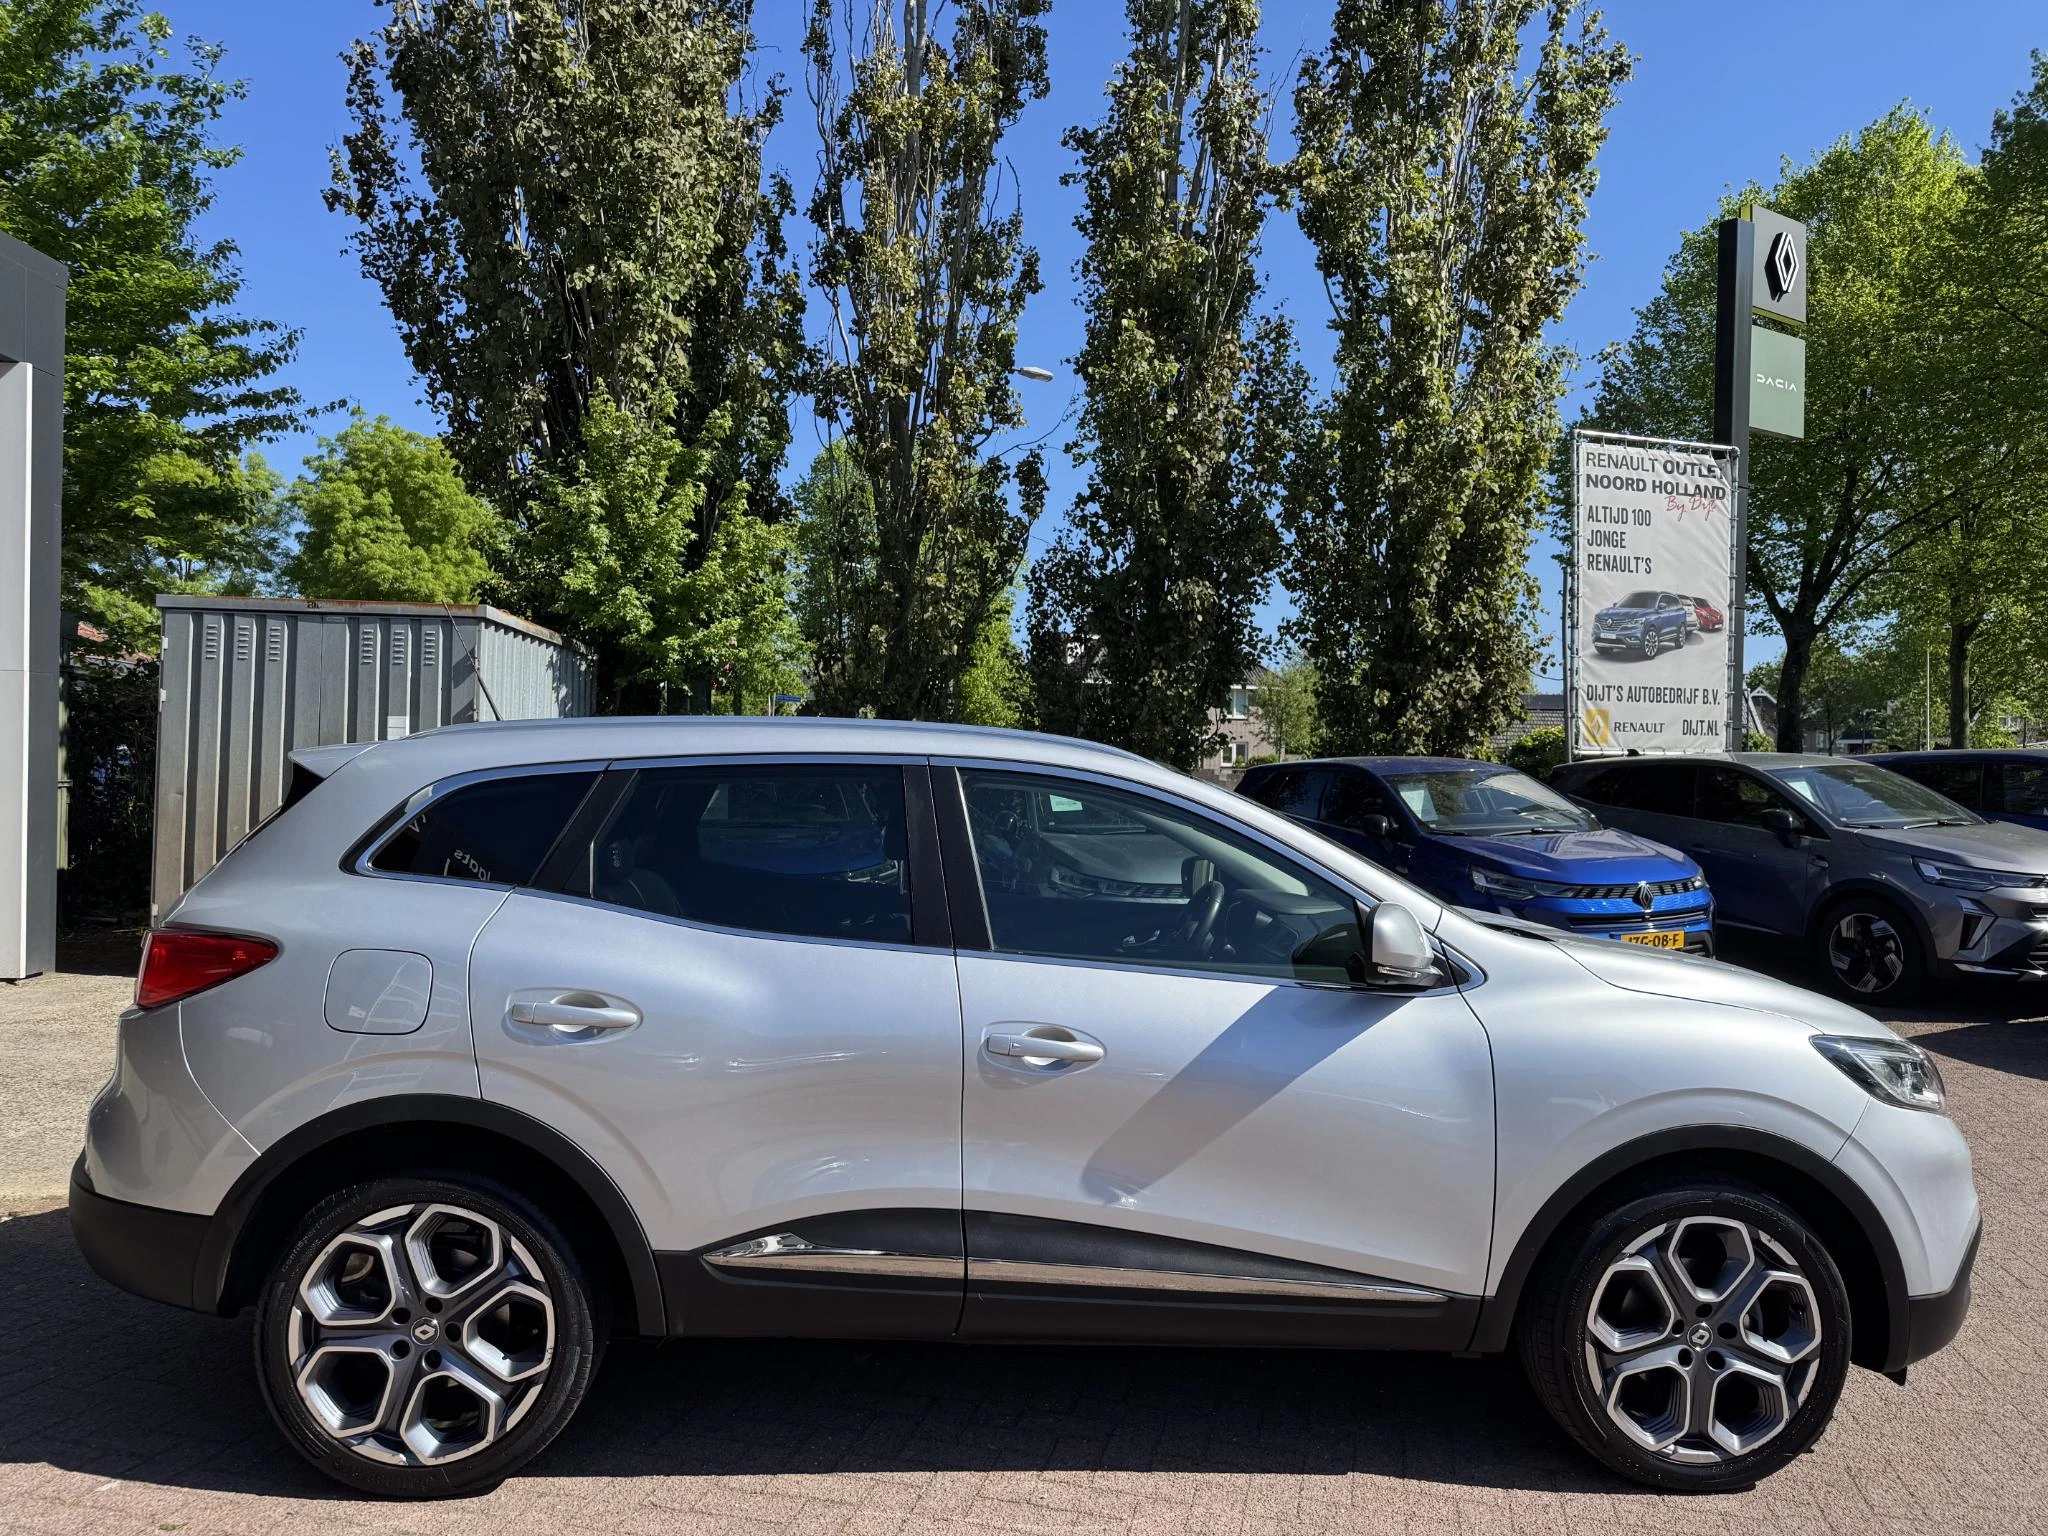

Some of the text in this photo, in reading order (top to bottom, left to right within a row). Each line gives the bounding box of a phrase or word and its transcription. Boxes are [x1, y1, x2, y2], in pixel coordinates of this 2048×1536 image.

[1756, 373, 1797, 392] DACIA
[1585, 452, 1658, 473] RENAULT
[1586, 474, 1726, 500] NOORD HOLLAND
[1587, 505, 1651, 527] ALTIJD 100
[1664, 495, 1686, 522] By
[1587, 529, 1626, 549] JONGE
[1587, 554, 1652, 574] RENAULT'S
[1586, 684, 1720, 706] DIJT'S AUTOBEDRIJF B.V.
[1613, 721, 1665, 734] RENAULT
[1682, 719, 1719, 737] DIJT.NL
